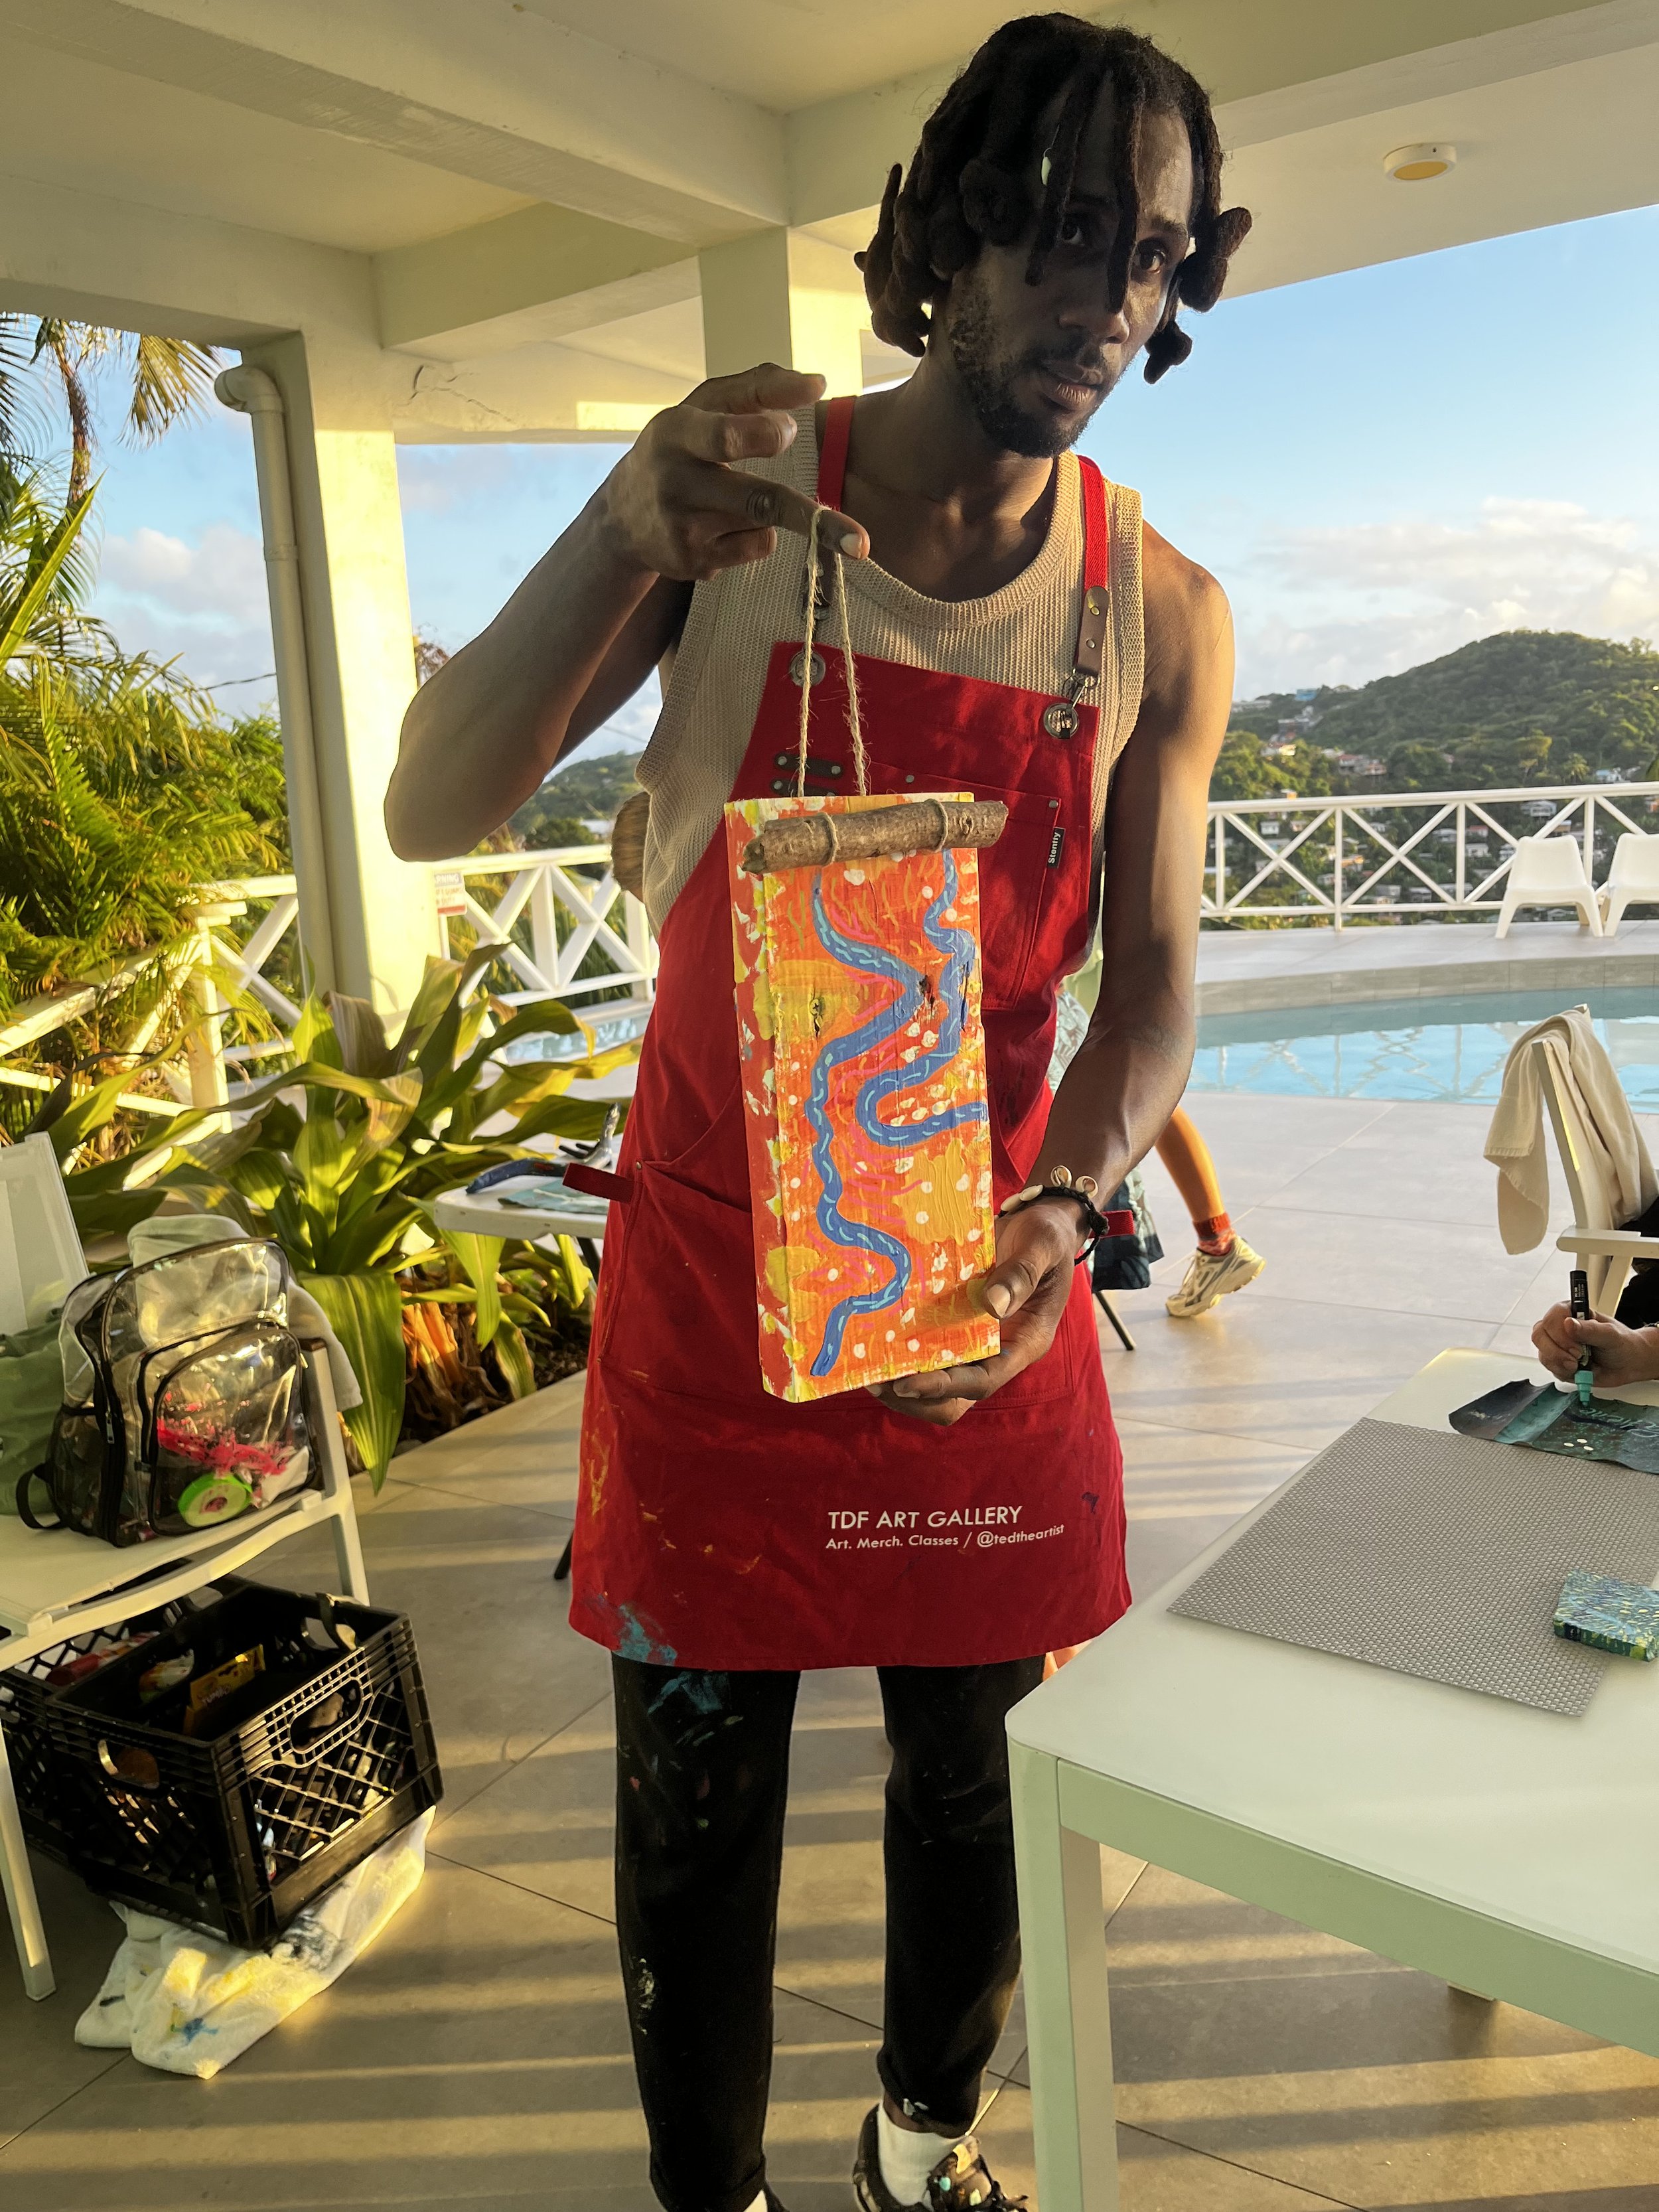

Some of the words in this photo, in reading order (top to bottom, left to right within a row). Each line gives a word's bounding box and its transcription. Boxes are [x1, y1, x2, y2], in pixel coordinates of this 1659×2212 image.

[828, 1511, 869, 1529] TDF
[876, 1511, 920, 1528] ART
[927, 1505, 1023, 1528] GALLERY
[826, 1538, 852, 1549] Art.
[856, 1535, 903, 1549] Merch.
[908, 1534, 959, 1546] Classes
[963, 1531, 973, 1548] /
[976, 1524, 1065, 1548] @tedtheartist
